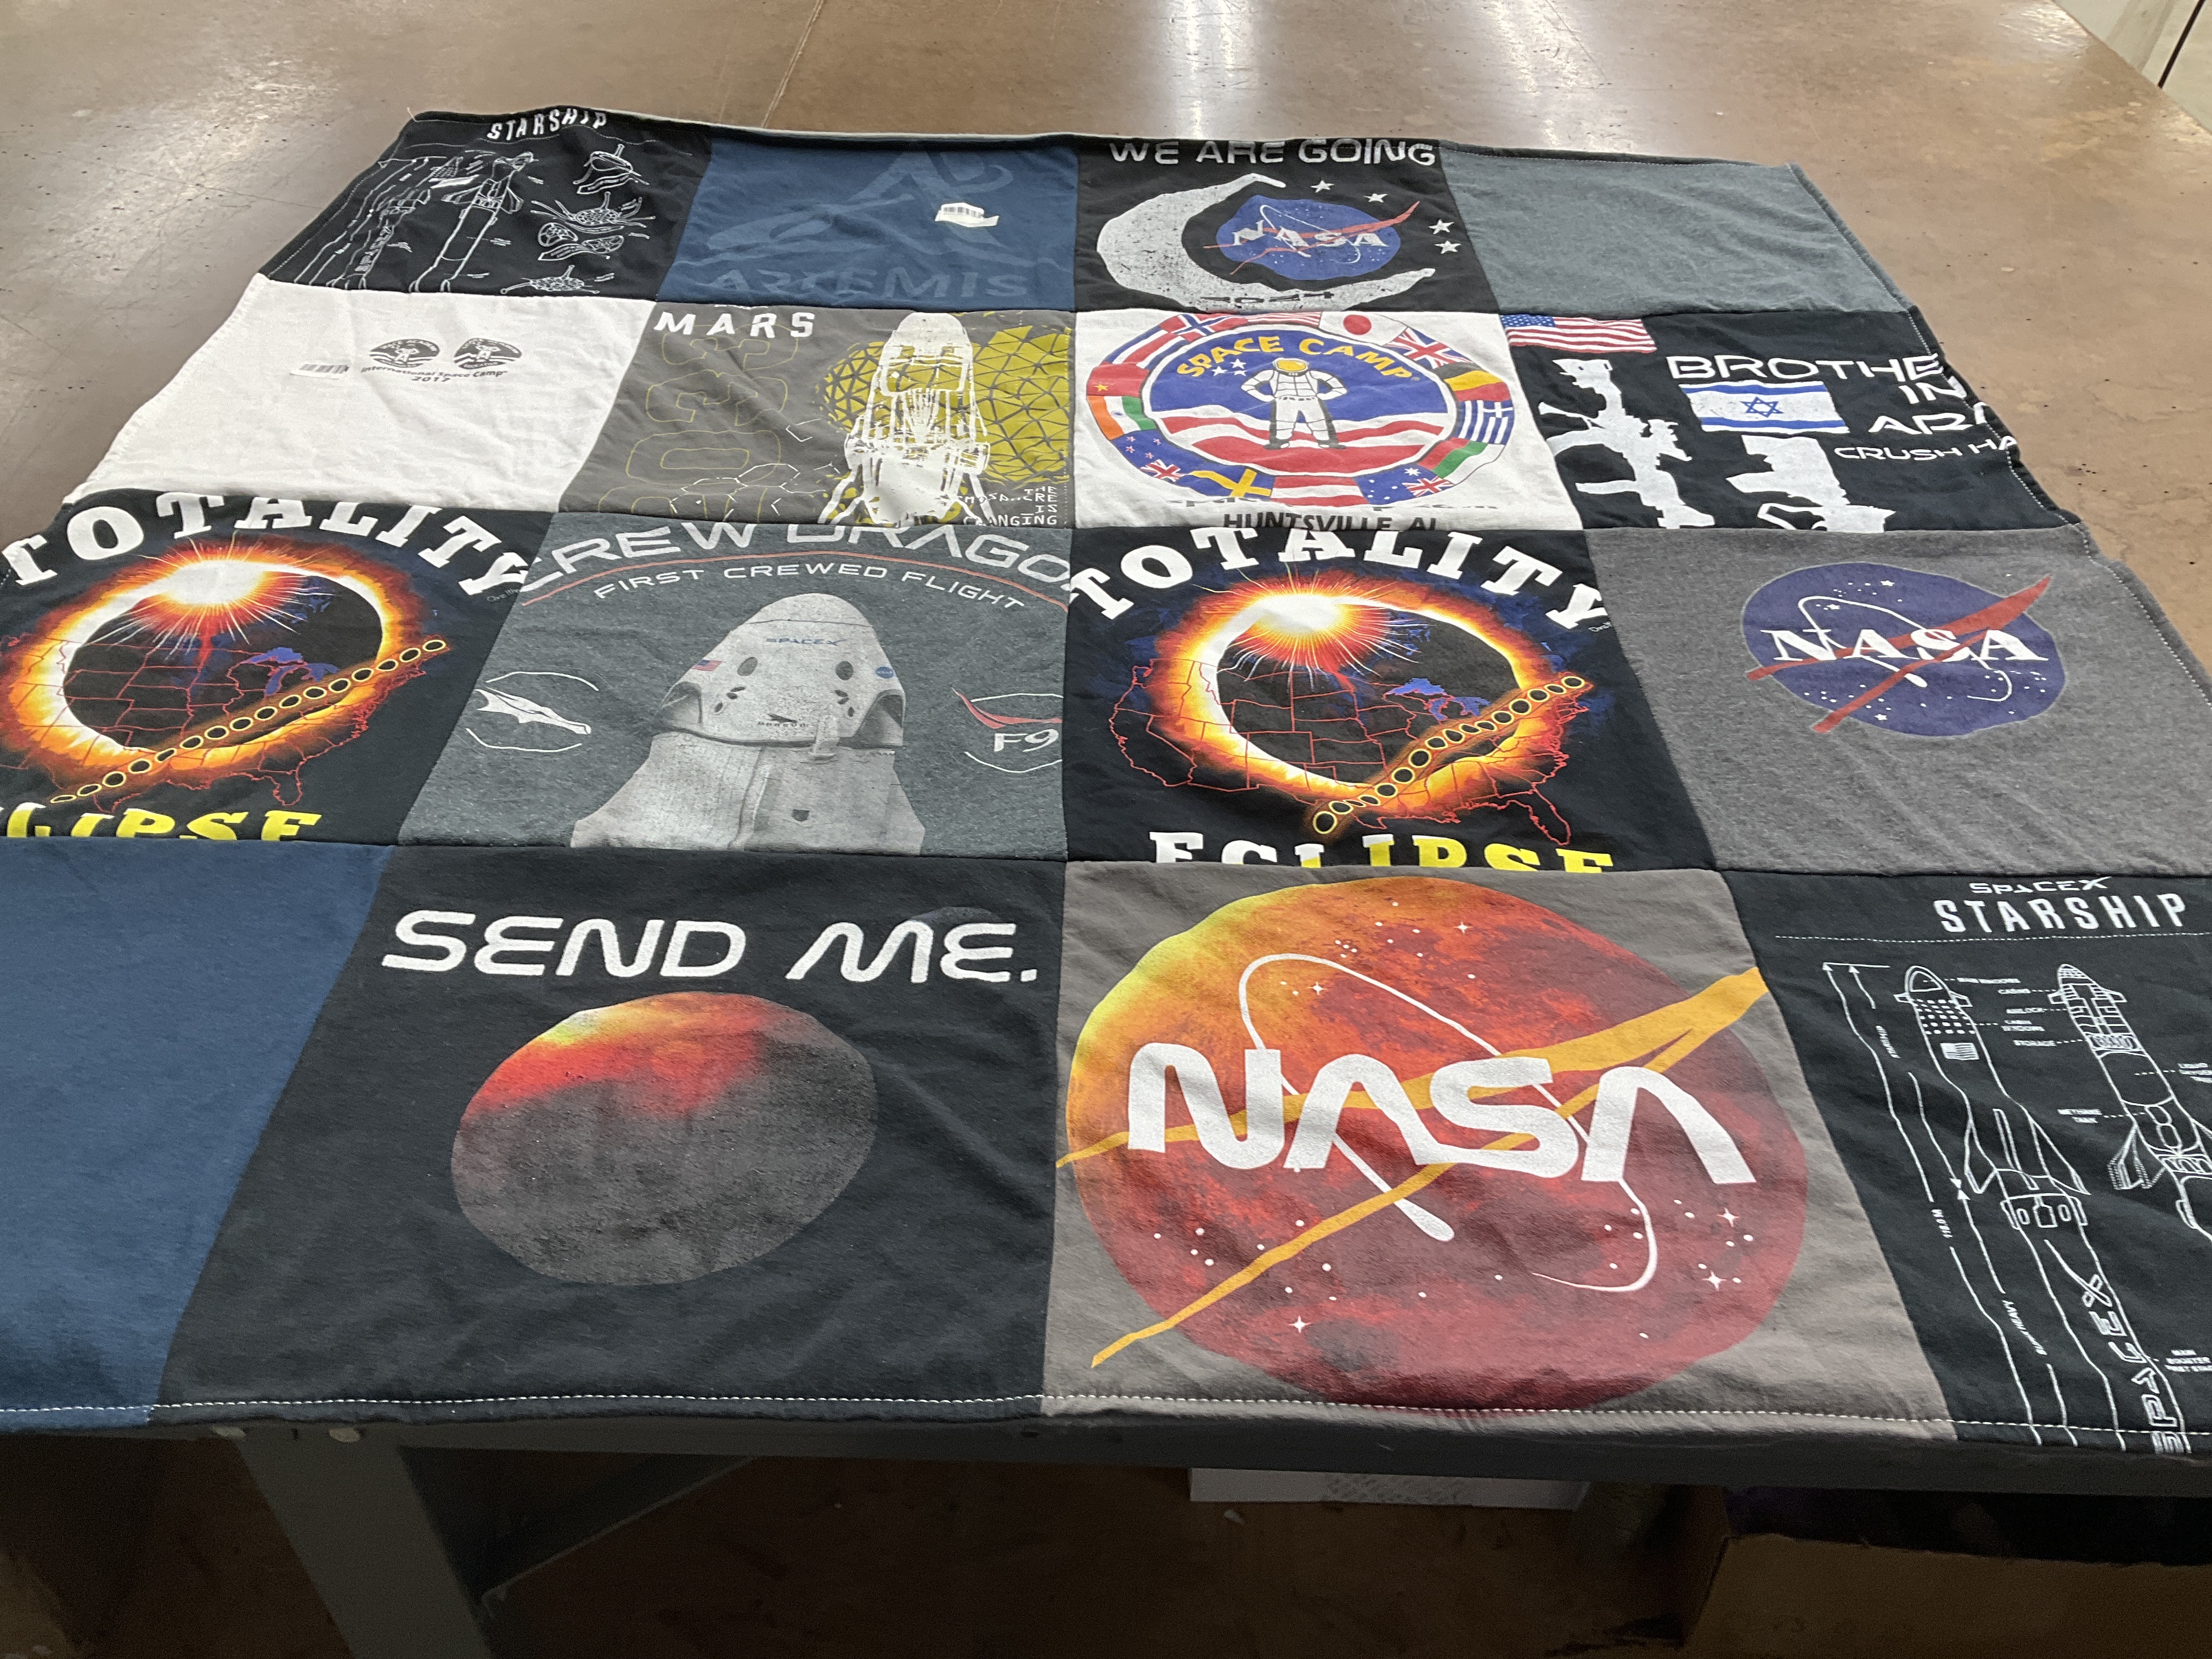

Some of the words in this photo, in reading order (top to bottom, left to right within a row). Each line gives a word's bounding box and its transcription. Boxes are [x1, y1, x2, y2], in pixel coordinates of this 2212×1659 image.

[487, 108, 607, 140] STARSHIP
[1109, 141, 1178, 164] WE
[1196, 140, 1285, 164] ARE
[1298, 138, 1436, 165] GOING
[1232, 219, 1389, 247] NASA
[654, 311, 815, 338] MARS
[360, 366, 435, 376] International
[1176, 336, 1284, 377] SPACE
[1666, 353, 1944, 382] BROTHE
[1898, 376, 1968, 404] IN
[1833, 447, 1963, 461] CRUSH
[963, 514, 1058, 527] CANGING
[1035, 504, 1058, 514] IS
[1, 491, 529, 596] TOTALITY
[787, 523, 1071, 591] DRAGO
[593, 569, 704, 599] FIRST
[724, 563, 888, 579] CREWED
[900, 572, 1026, 610] FLIGHT
[1069, 527, 1609, 629] TOTALITY
[1760, 628, 2049, 662] NASA
[994, 729, 1060, 753] F9
[0, 802, 323, 842] LIPSE
[1969, 876, 2112, 894] SPACEX
[1933, 893, 2187, 934] STARSHIP
[381, 909, 747, 978] SEND
[785, 920, 1039, 984] ME.
[1127, 1042, 1757, 1184] NASA
